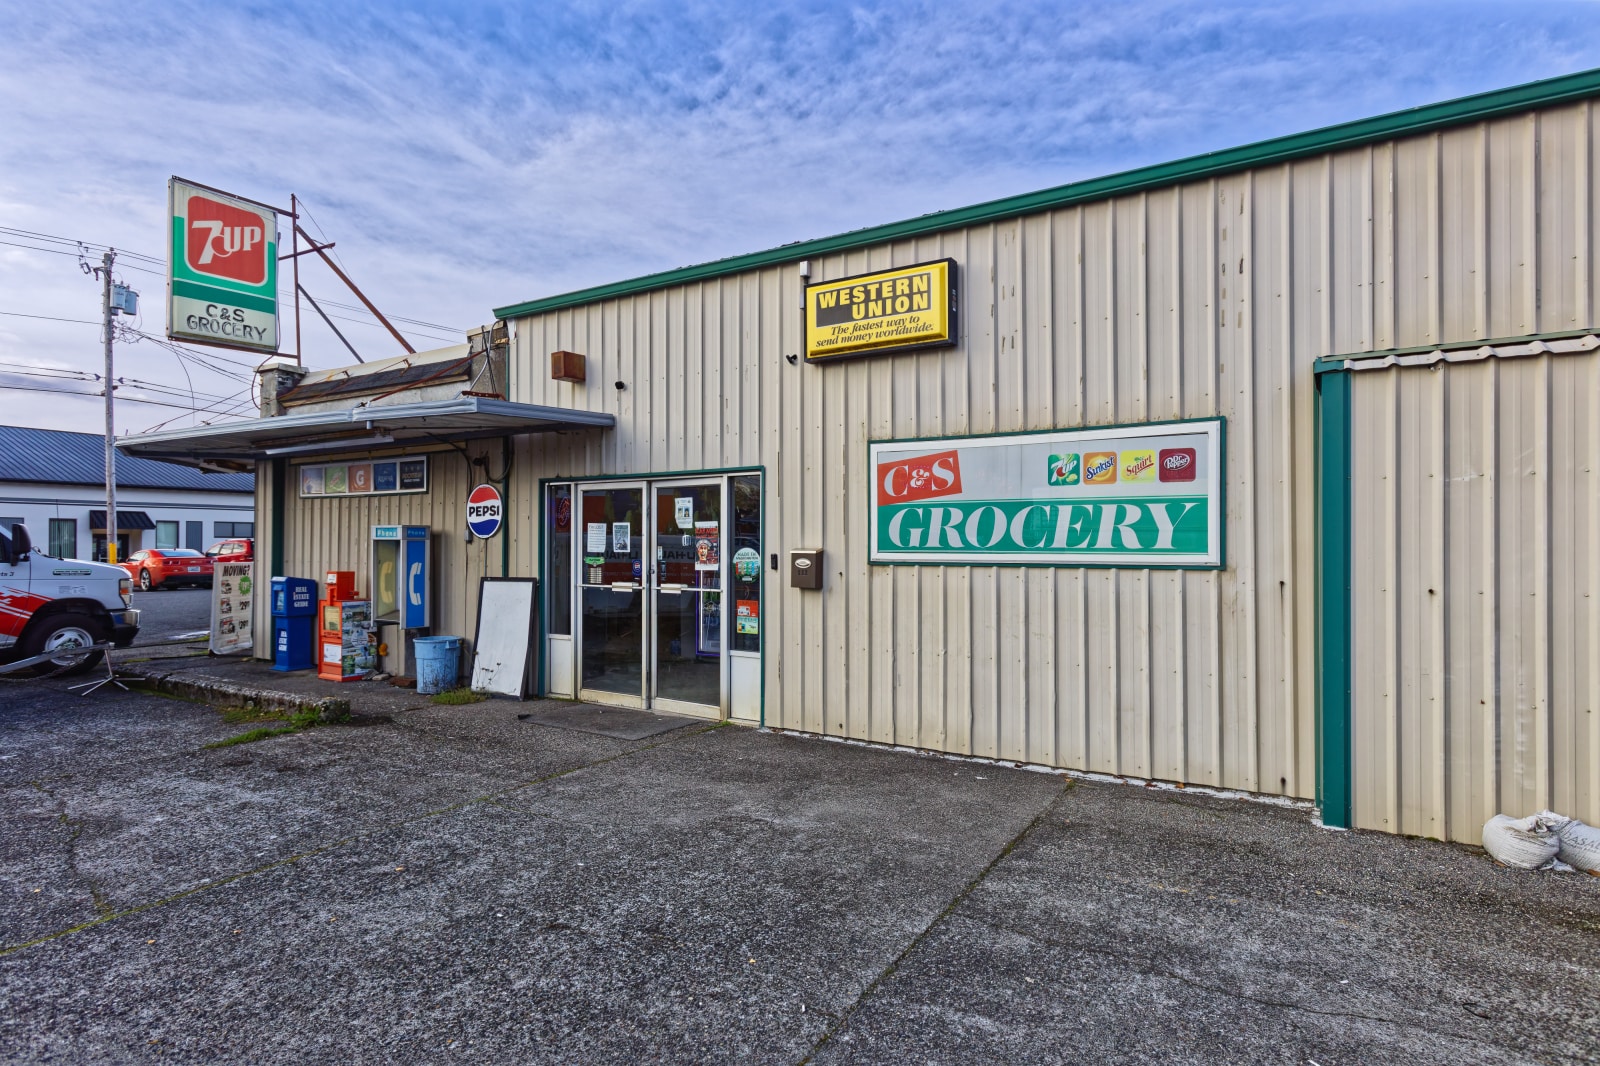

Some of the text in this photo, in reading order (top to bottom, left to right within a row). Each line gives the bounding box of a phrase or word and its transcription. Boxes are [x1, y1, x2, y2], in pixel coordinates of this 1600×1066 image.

[818, 274, 928, 309] WESTERN
[205, 303, 245, 322] C&S
[851, 292, 929, 320] UNION
[187, 314, 267, 341] GROCERY
[816, 321, 934, 348] send money worldwide.
[831, 315, 921, 337] The fastest way to
[356, 470, 366, 486] G
[883, 457, 956, 498] C&S
[1086, 455, 1116, 481] Sunkist
[468, 504, 500, 518] PEPSI
[888, 502, 1201, 550] GROCERY
[222, 565, 251, 577] MOVING?
